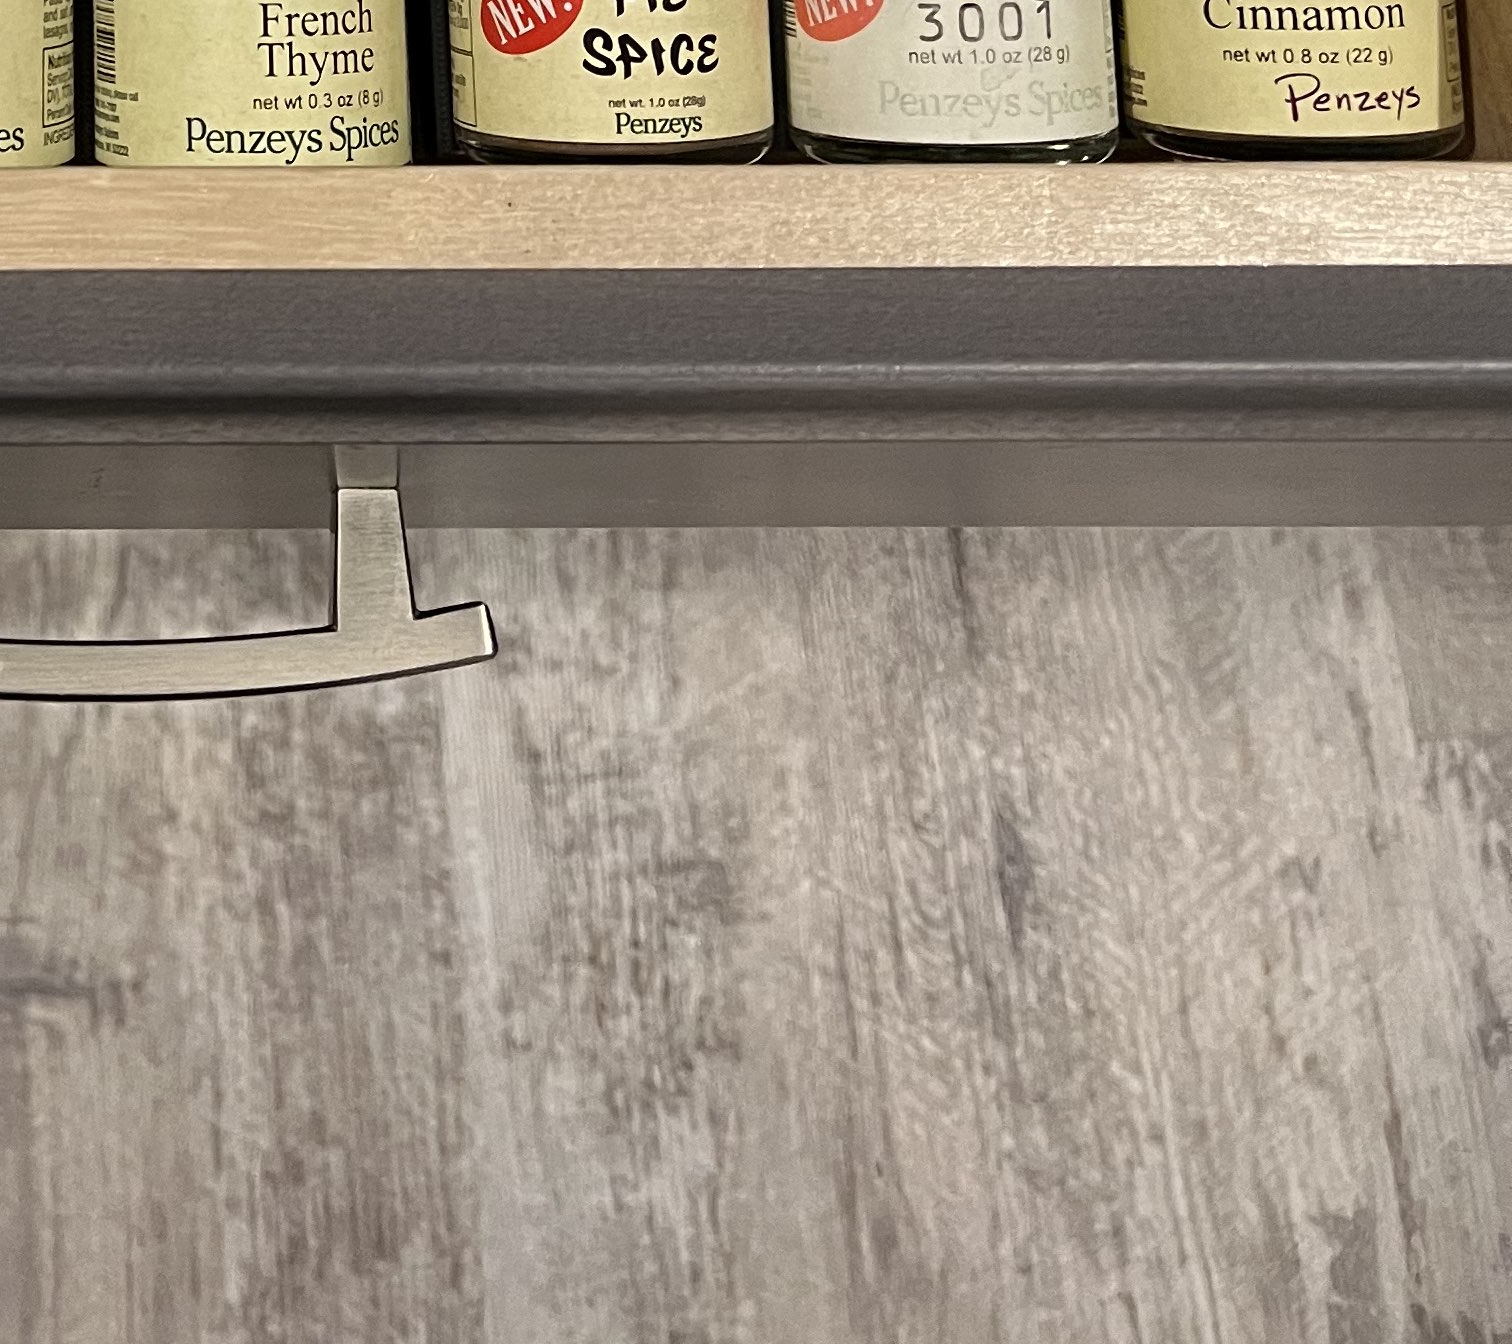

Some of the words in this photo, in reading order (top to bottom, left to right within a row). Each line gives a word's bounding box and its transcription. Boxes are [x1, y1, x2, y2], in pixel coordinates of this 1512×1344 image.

[257, 41, 375, 86] Thyme
[582, 28, 720, 80] SPICE
[1274, 72, 1420, 122] Penzeys
[615, 112, 703, 138] Penzeys
